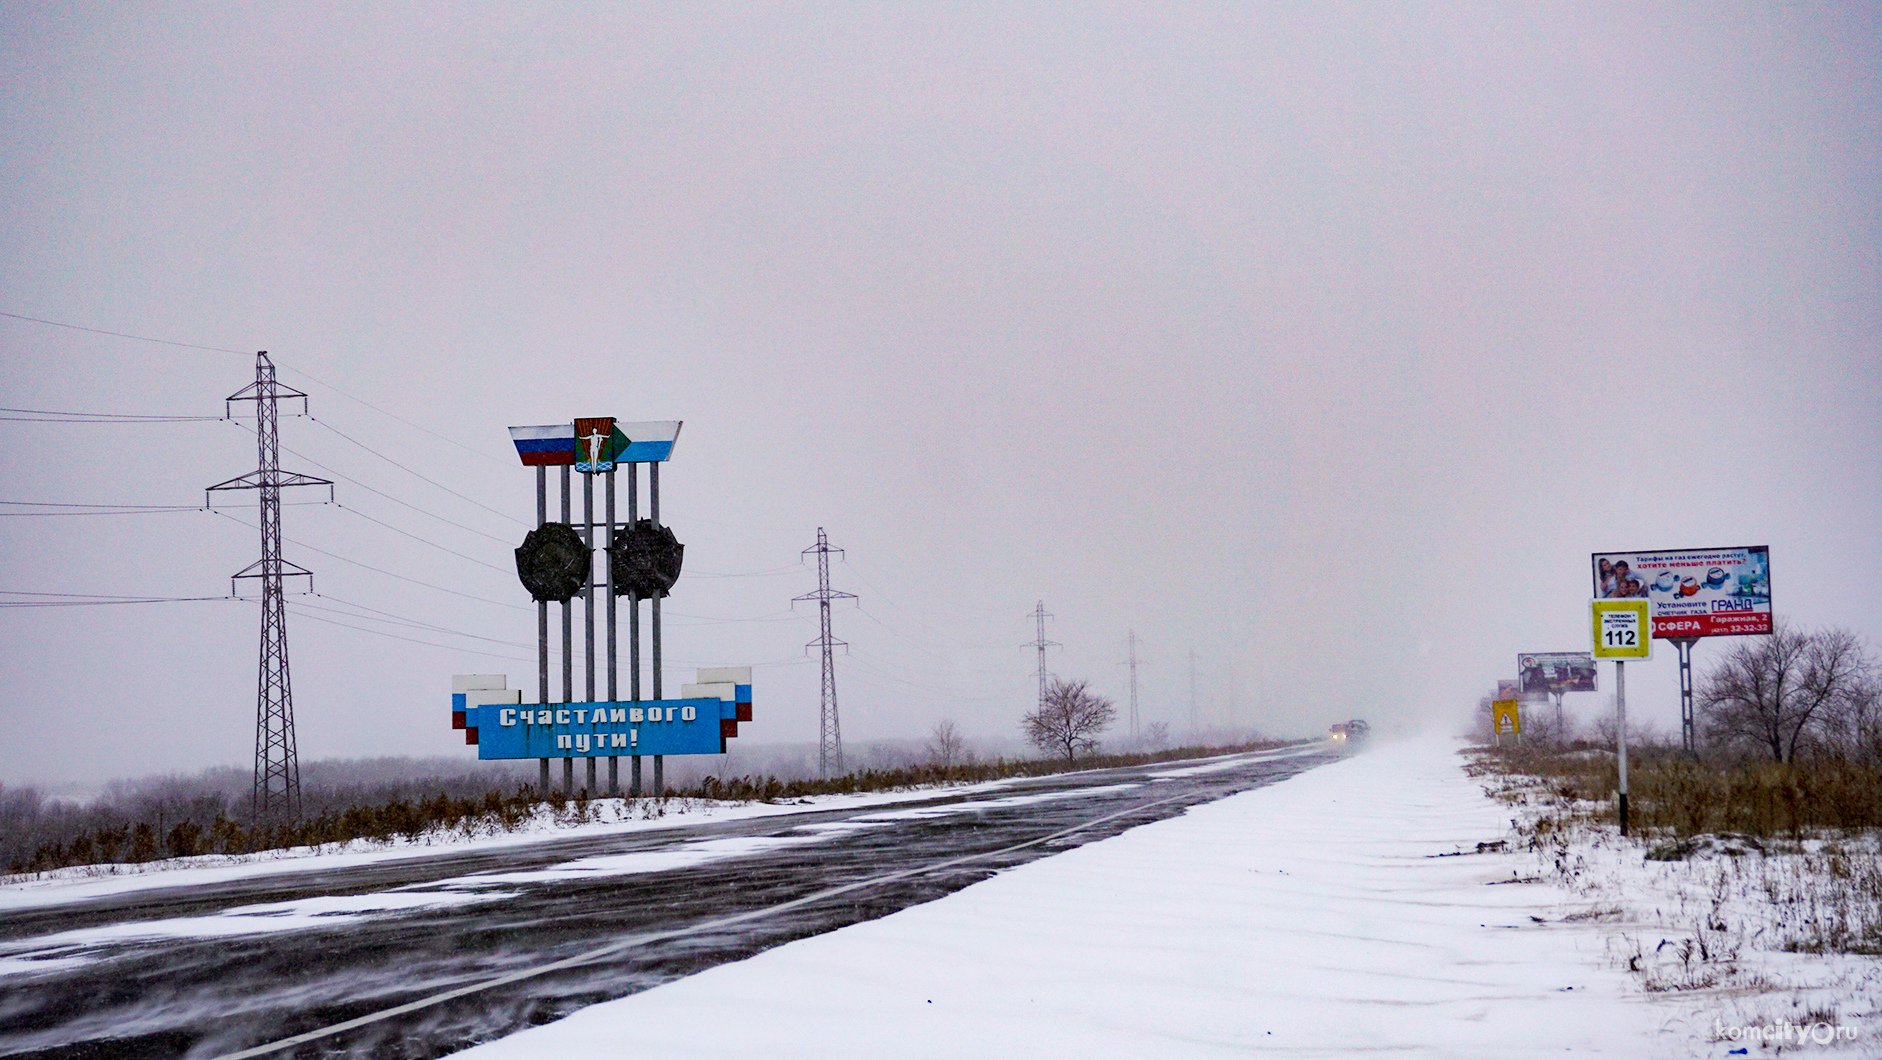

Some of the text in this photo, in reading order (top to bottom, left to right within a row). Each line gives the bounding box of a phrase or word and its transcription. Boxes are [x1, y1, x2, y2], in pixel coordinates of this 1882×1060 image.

[1706, 558, 1746, 566] платить?
[1656, 598, 1753, 611] Установите ГРАНД
[1710, 614, 1759, 623] Гаражная,
[1658, 621, 1702, 631] СФЕРА
[1730, 624, 1768, 632] 32-32-32
[1605, 630, 1636, 646] 112
[499, 706, 697, 727] Счастливого
[556, 729, 638, 753] пути!
